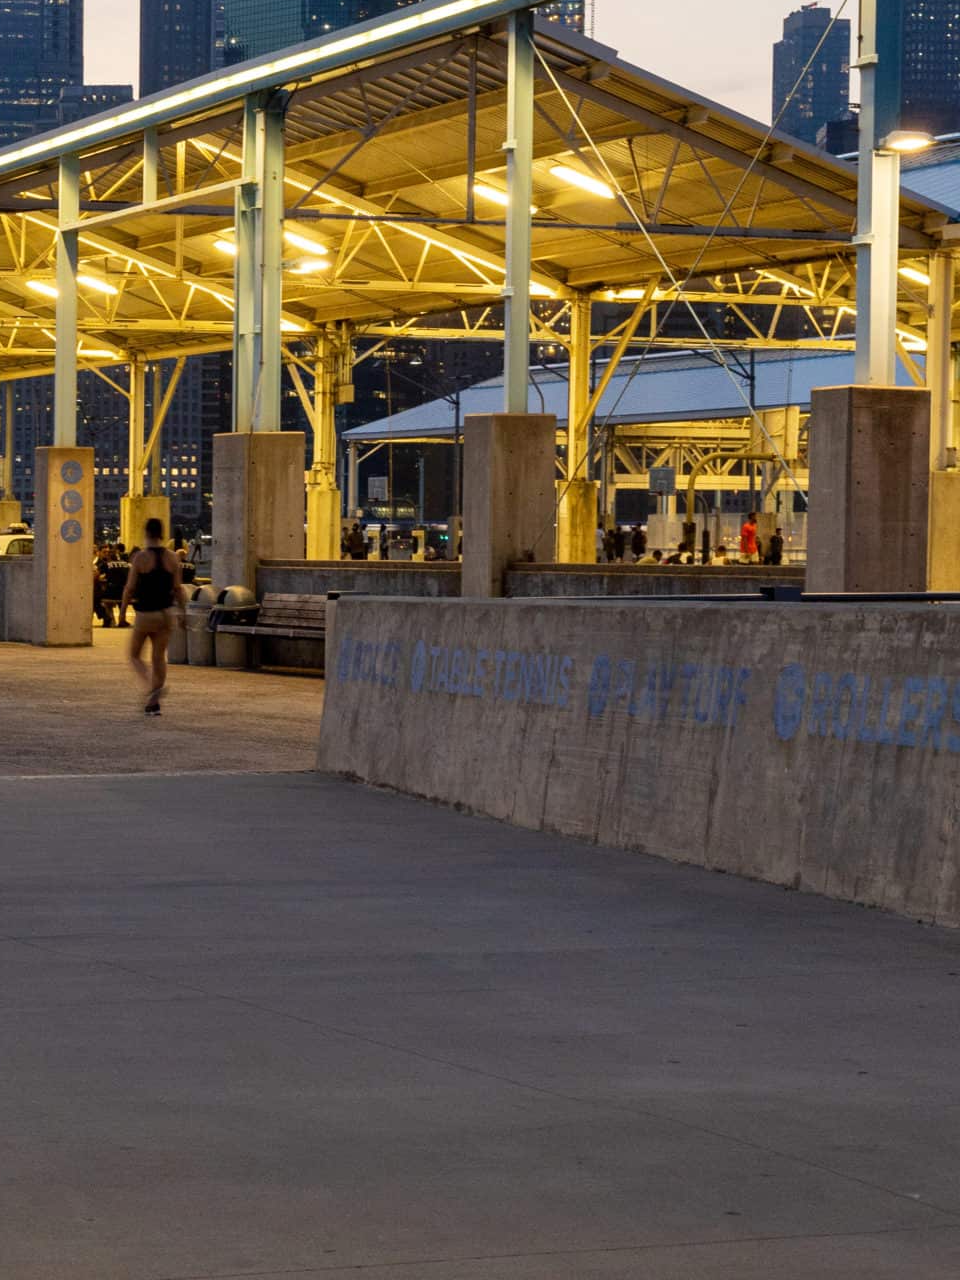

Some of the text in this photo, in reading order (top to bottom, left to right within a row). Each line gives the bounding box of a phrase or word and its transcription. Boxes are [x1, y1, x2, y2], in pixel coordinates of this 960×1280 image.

[431, 646, 574, 707] TABLE TENNIS
[681, 662, 751, 727] TURF
